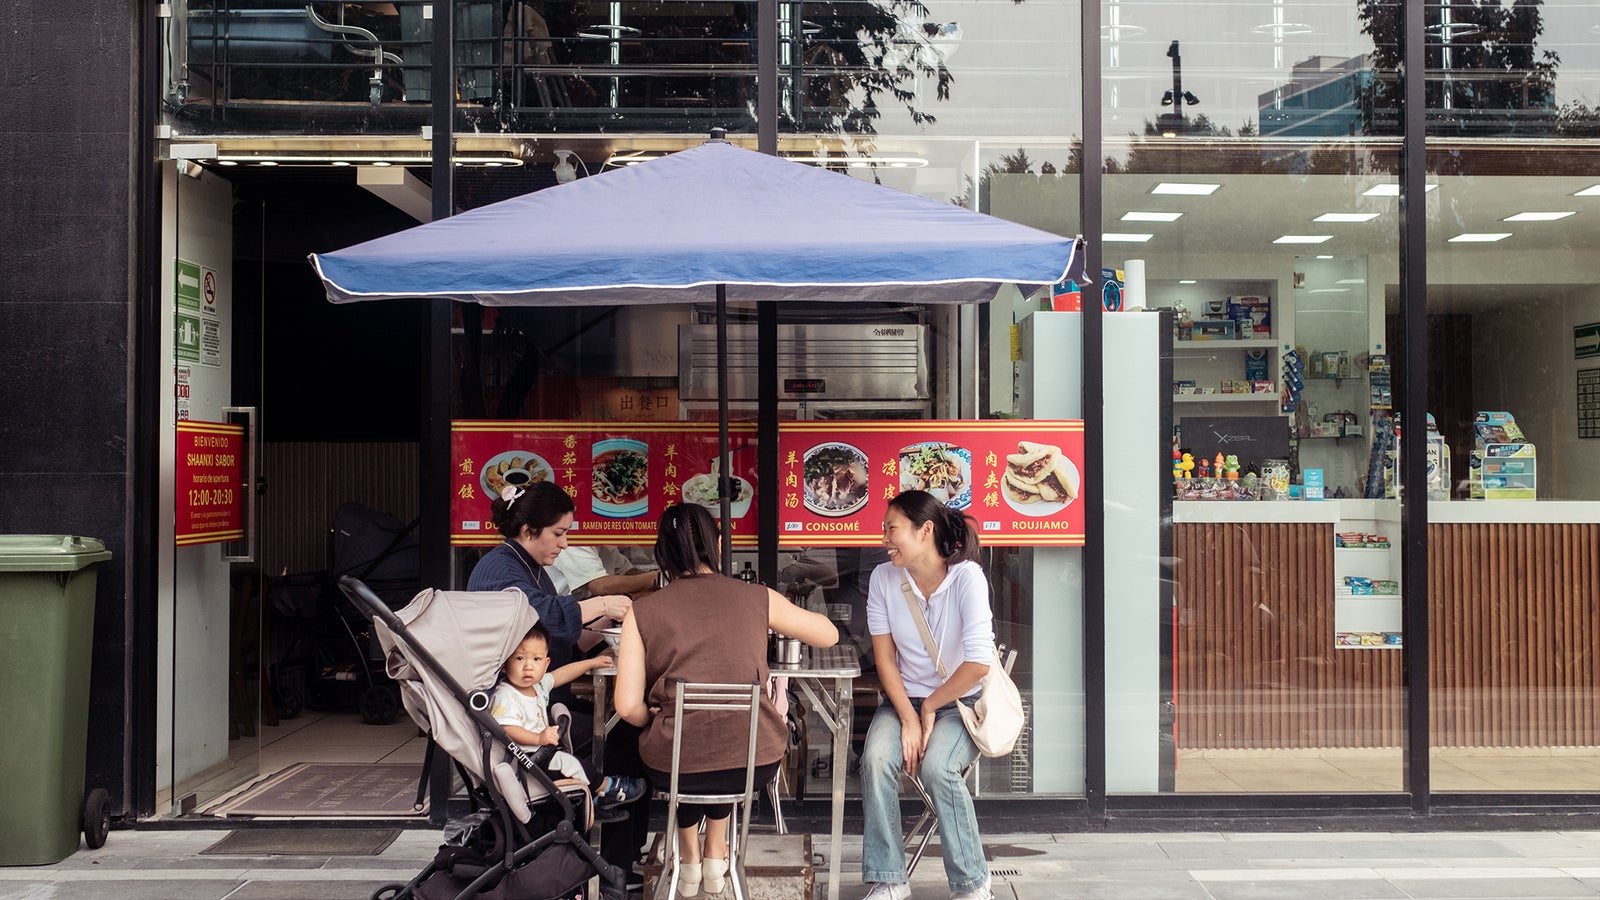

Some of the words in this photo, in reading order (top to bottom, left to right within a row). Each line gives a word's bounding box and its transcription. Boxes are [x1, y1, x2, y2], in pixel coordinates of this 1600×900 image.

[620, 395, 668, 411] 出餐口
[194, 435, 229, 448] BIENVENIDO
[187, 453, 214, 467] SHAANXI
[215, 454, 235, 467] SABOR
[207, 474, 213, 483] de
[458, 457, 475, 500] 煎饺
[562, 434, 578, 512] 番茄牛腩
[784, 450, 799, 509] 羊肉汤
[882, 458, 898, 500] 凉皮
[983, 450, 1000, 508] 肉夹馍
[189, 489, 233, 506] 12:00-20:30
[582, 521, 603, 530] RAMEN
[603, 521, 611, 530] DE
[611, 521, 622, 530] RES
[622, 521, 635, 530] CON
[635, 521, 657, 530] TOMATE
[805, 520, 860, 532] CONSOMÉ
[1012, 520, 1069, 531] ROUJIAMO
